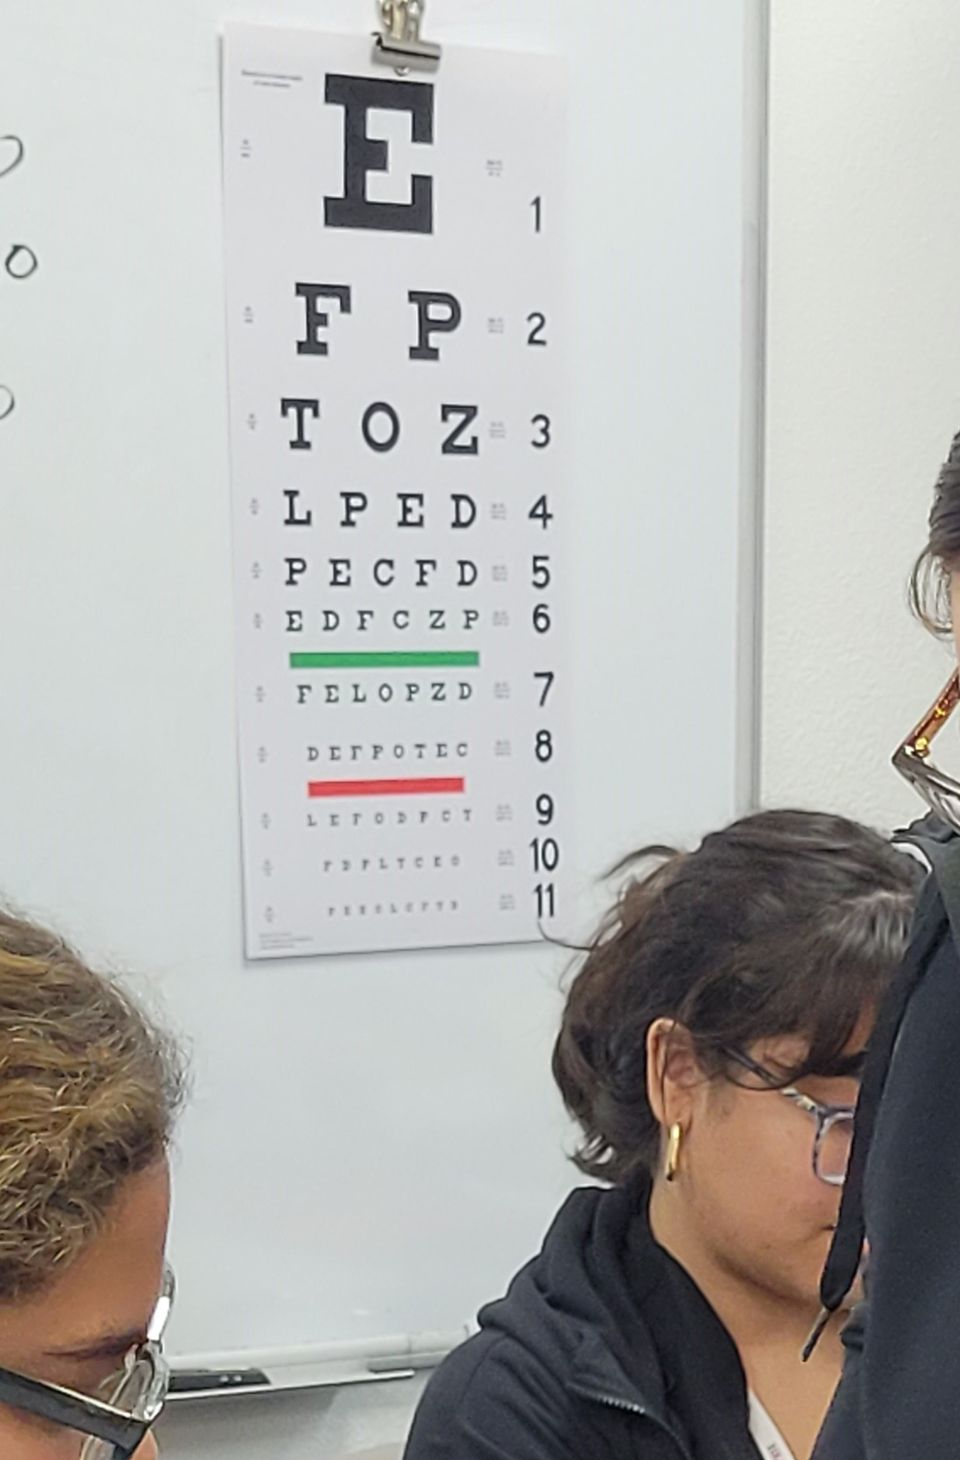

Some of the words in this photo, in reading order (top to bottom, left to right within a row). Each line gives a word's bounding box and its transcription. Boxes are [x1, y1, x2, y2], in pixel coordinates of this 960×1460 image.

[324, 73, 434, 234] E
[532, 197, 541, 233] 1
[295, 282, 351, 356] F
[408, 291, 461, 361] P
[528, 313, 547, 346] 2
[281, 398, 319, 450] T
[362, 402, 400, 452] O
[441, 404, 478, 455] Z
[531, 414, 550, 449] 3
[282, 489, 312, 527] L
[339, 491, 368, 528] P
[396, 492, 425, 528] E
[450, 493, 477, 529] D
[528, 495, 553, 530] 4
[533, 556, 550, 590] 5
[533, 604, 550, 633] 6
[534, 672, 555, 707] 7
[535, 730, 552, 762] 8
[536, 794, 554, 826] 9
[530, 838, 559, 873] 10
[534, 884, 555, 919] 11
